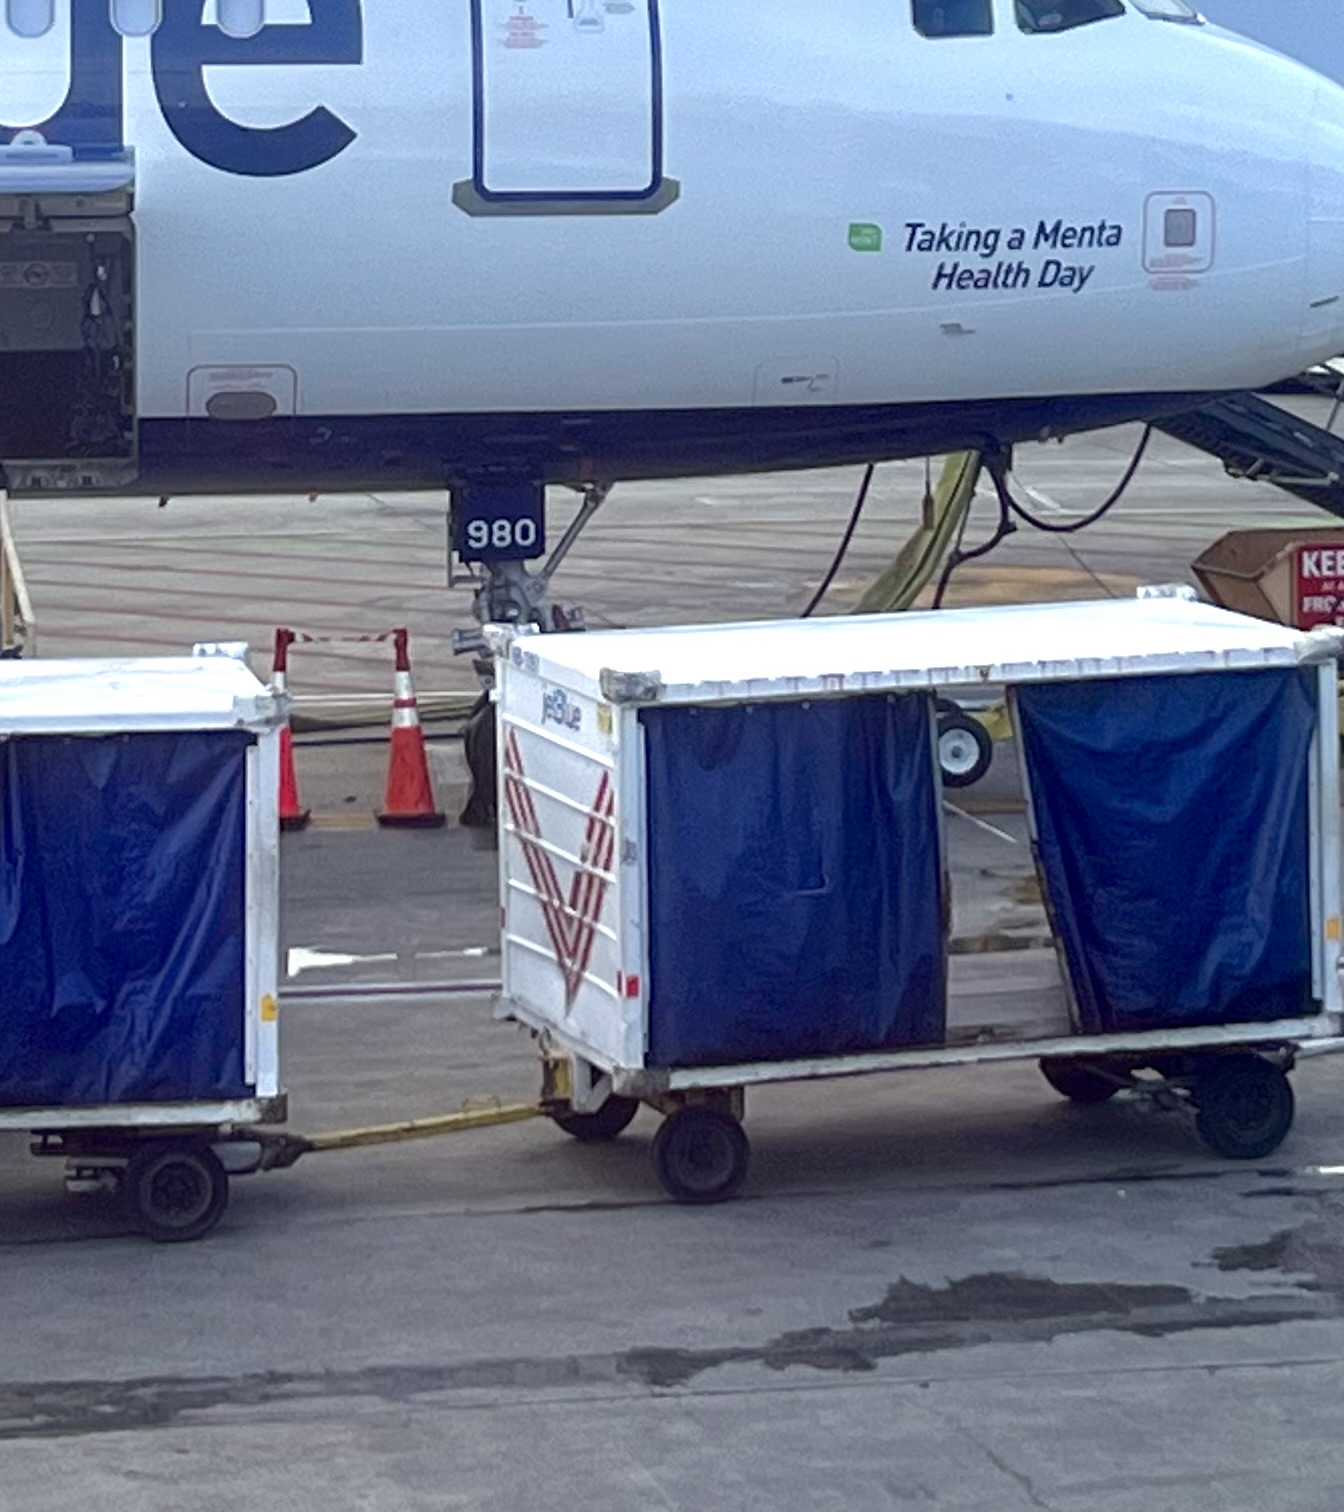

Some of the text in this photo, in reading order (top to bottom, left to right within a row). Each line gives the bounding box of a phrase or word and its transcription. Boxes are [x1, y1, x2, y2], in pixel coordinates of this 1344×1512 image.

[904, 221, 1001, 258] Taking
[1006, 229, 1026, 251] a
[931, 259, 1096, 293] Health Day
[467, 518, 536, 548] 980
